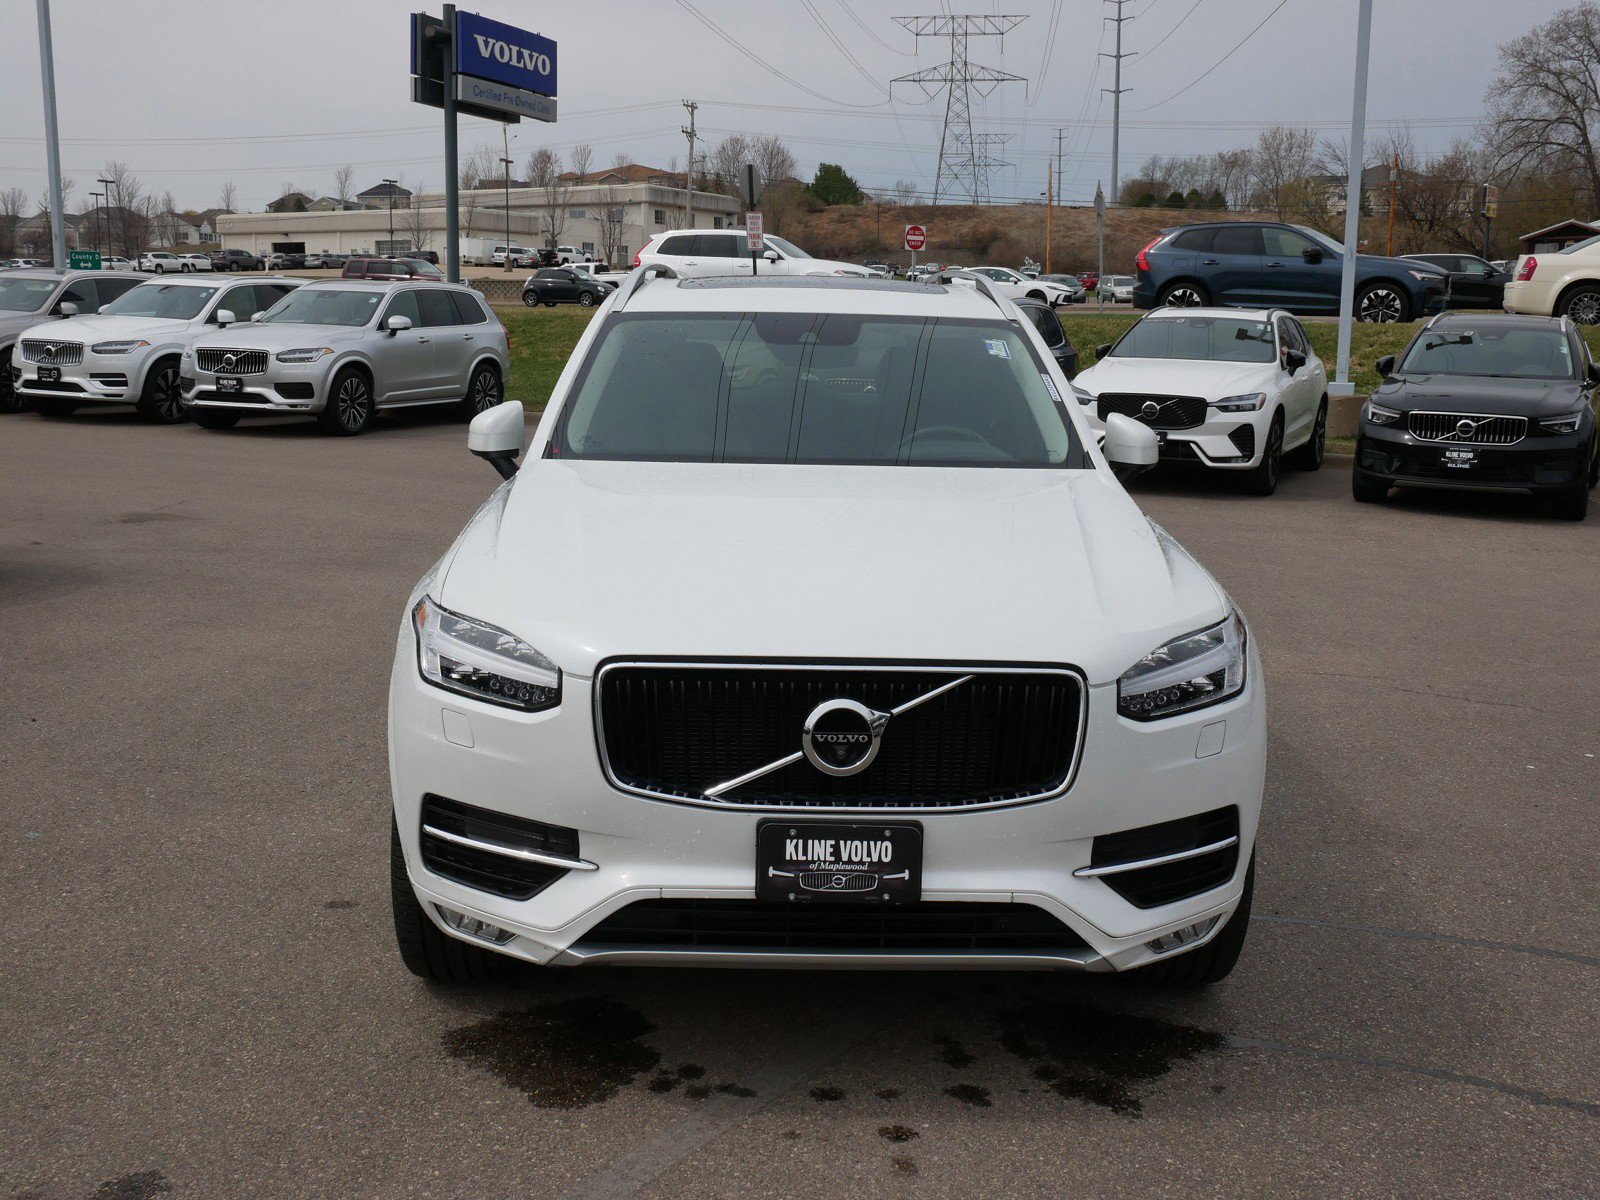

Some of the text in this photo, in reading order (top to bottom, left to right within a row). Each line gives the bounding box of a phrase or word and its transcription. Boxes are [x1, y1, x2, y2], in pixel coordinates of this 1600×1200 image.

[473, 34, 551, 76] VOLVO
[473, 85, 550, 114] Certified Pre Owned Cars
[815, 734, 869, 743] VOLVO
[785, 838, 892, 863] KLINE VOLVO
[809, 861, 869, 871] of Maplewood
